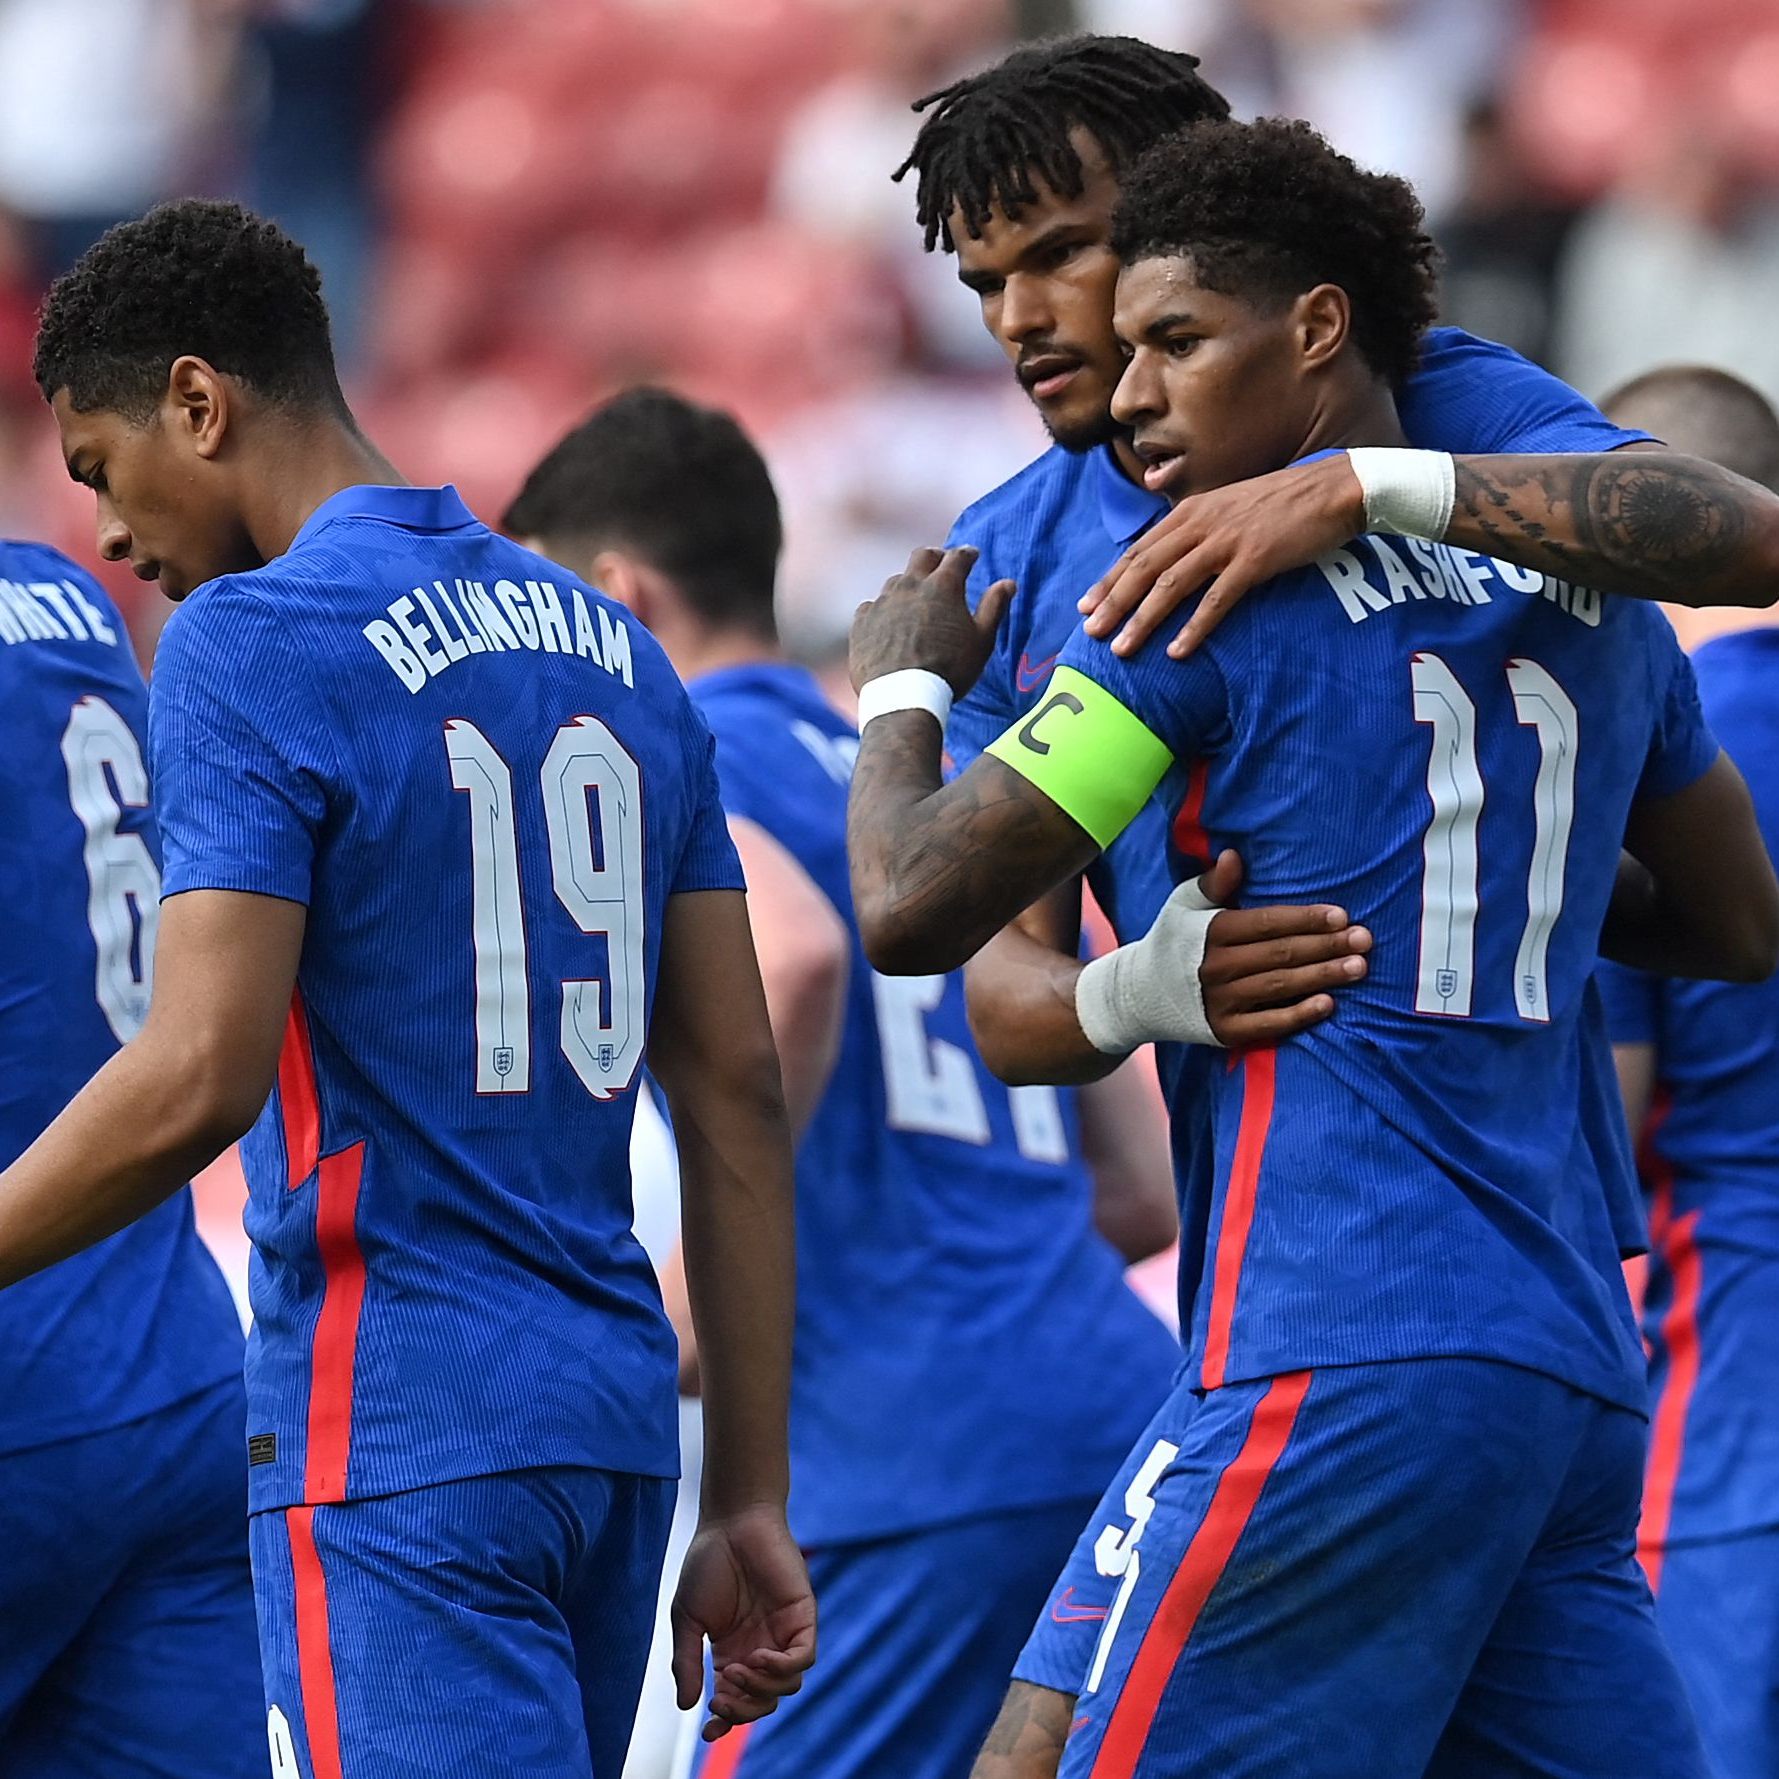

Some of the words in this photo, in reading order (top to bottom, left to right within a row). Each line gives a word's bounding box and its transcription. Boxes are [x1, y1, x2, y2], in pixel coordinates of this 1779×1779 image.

[362, 578, 634, 695] BELLINGHAM
[1018, 692, 1084, 756] C
[60, 695, 161, 1047] 6
[444, 714, 645, 1101] 19
[1410, 651, 1578, 1023] 11
